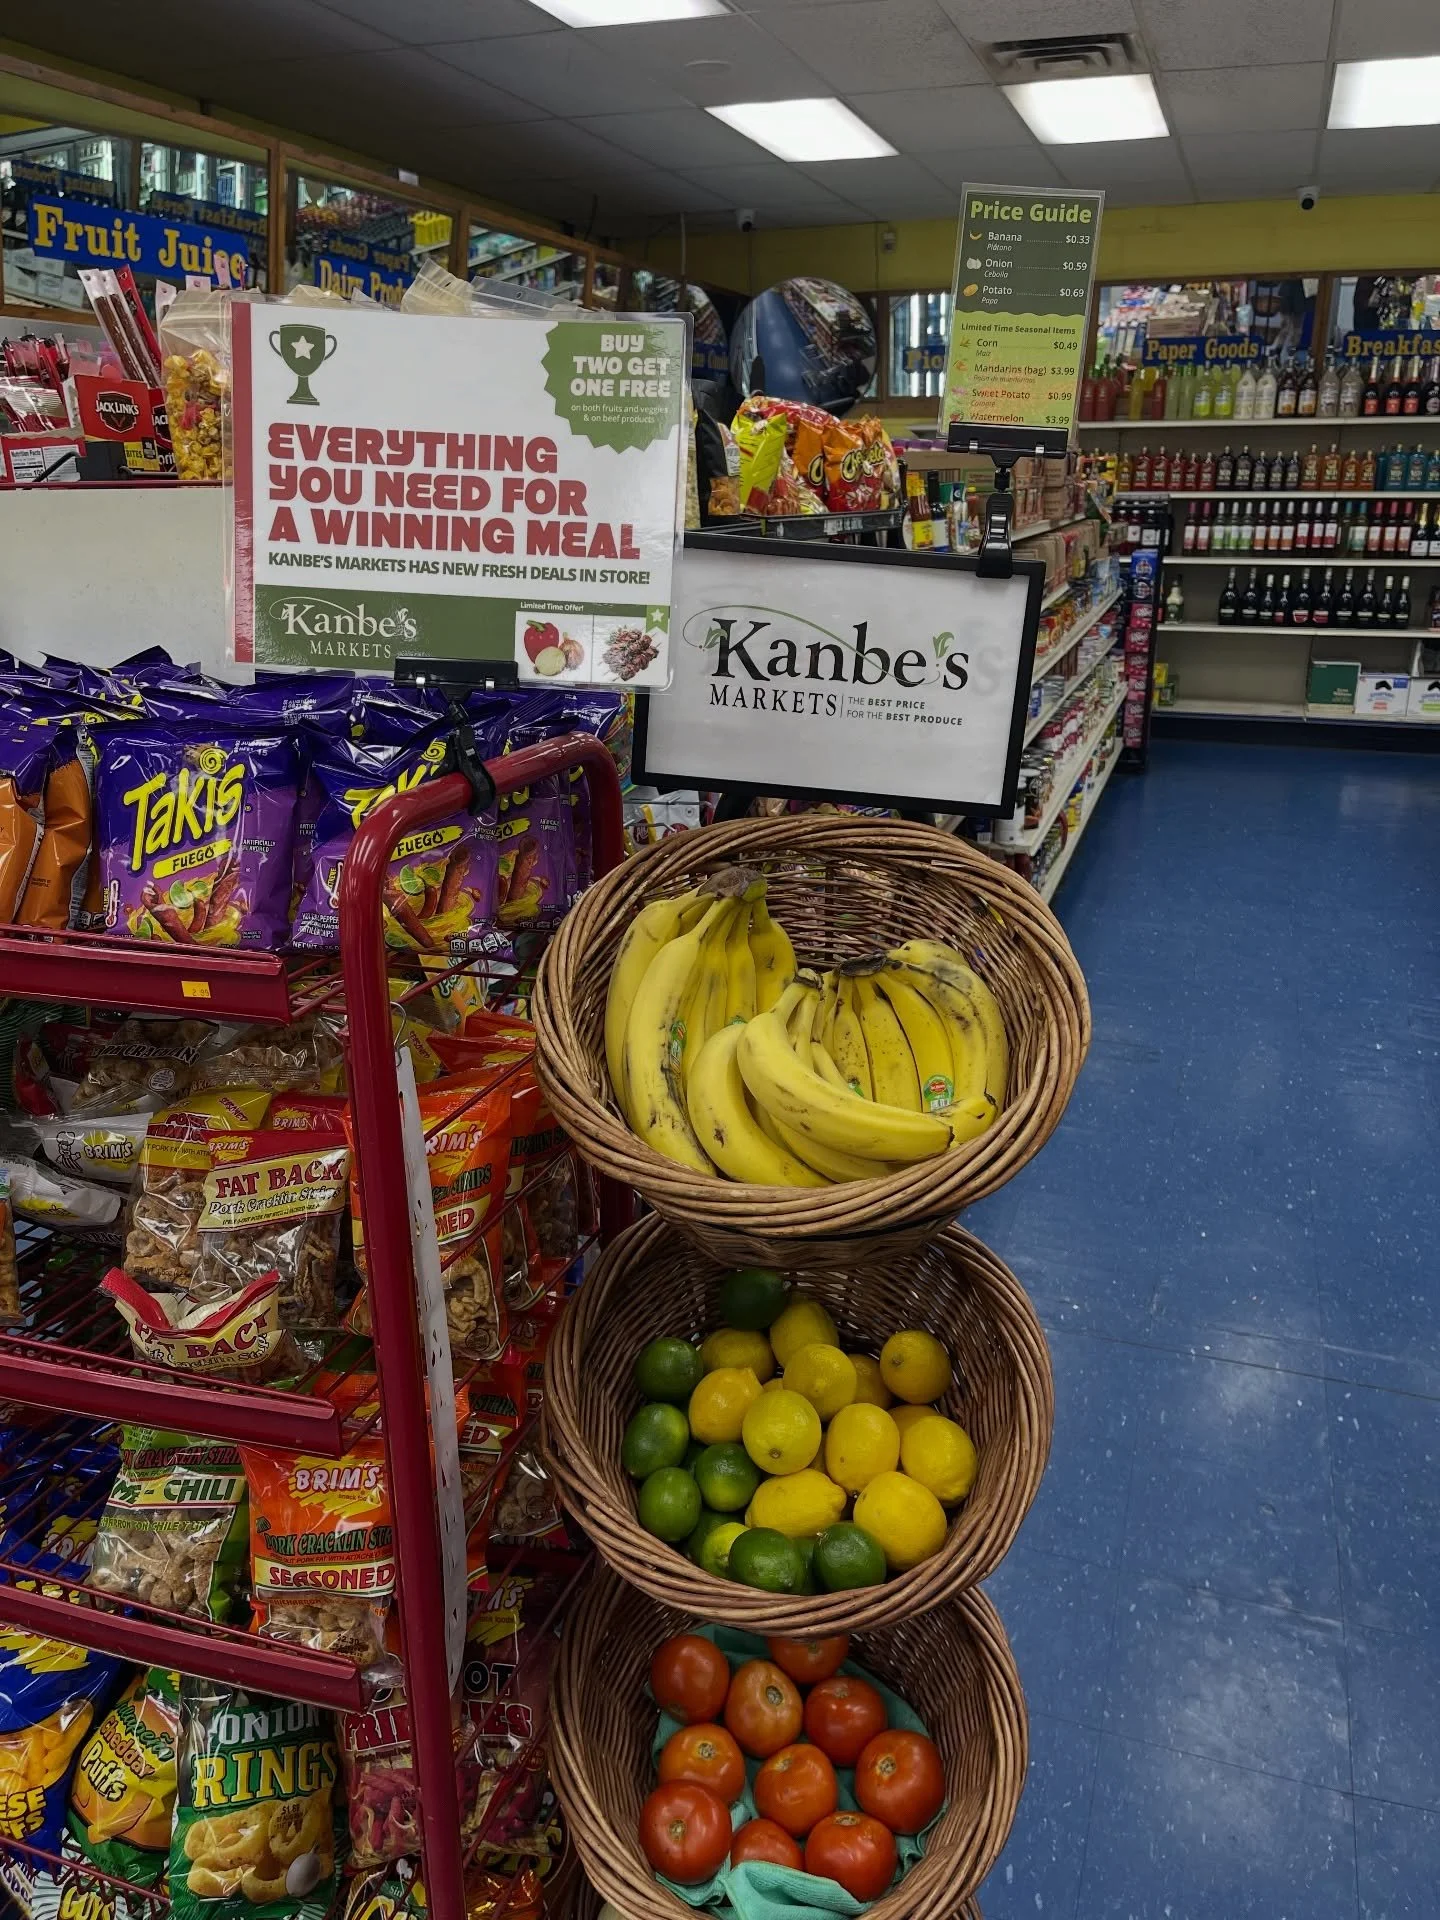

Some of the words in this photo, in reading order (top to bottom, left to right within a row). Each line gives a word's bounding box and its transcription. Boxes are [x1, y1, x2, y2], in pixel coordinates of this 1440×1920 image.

[970, 200, 1024, 221] Price
[1029, 203, 1092, 223] Guide
[33, 203, 141, 261] Fruit
[988, 231, 1022, 242] Banana
[1065, 235, 1090, 244] $0.33
[984, 270, 1008, 278] Cebolla
[985, 258, 1013, 268] Onion
[1062, 261, 1087, 271] $0.59
[982, 286, 1013, 295] Potato
[1059, 288, 1084, 298] $0.69
[961, 323, 993, 332] Limited
[994, 324, 1013, 333] Time
[1015, 325, 1051, 334] Seasonal
[1052, 327, 1076, 335] Items
[600, 334, 644, 352] BUY
[976, 338, 998, 347] Corn
[1053, 342, 1078, 351] $0.49
[1144, 338, 1197, 361] Paper
[1204, 337, 1259, 359] Goods
[573, 355, 623, 375] TWO
[627, 357, 671, 376] GET
[974, 364, 1022, 374] Mandarins
[1024, 365, 1047, 377] (bag)
[1051, 367, 1075, 376] $3.99
[570, 378, 614, 397] ONE
[619, 379, 671, 398] FREE
[972, 388, 999, 398] Sweet
[1001, 390, 1030, 400] Potato
[1048, 391, 1072, 401] $0.99
[96, 400, 115, 414] JACK
[571, 404, 581, 412] on
[582, 404, 601, 413] both
[602, 404, 623, 413] fruits
[624, 404, 639, 414] and
[640, 406, 669, 416] veggies
[970, 412, 1024, 423] Watermelon
[1045, 415, 1070, 425] $3.99
[583, 414, 590, 422] &
[602, 414, 620, 423] beef
[621, 415, 655, 425] products
[267, 422, 558, 474] EVERYTHING
[269, 464, 363, 506] YOU
[374, 470, 492, 511] NEED
[502, 476, 588, 517] FOR
[268, 506, 301, 543] A
[310, 508, 515, 555] WINNING
[526, 519, 641, 560] MEAL
[268, 551, 333, 569] KANBE'S
[335, 556, 406, 573] MARKETS
[409, 560, 440, 574] HAS
[442, 562, 479, 577] NEW
[482, 563, 527, 580] FRESH
[530, 566, 577, 582] DEALS
[579, 568, 597, 583] IN
[599, 569, 650, 585] STORE!
[520, 601, 546, 610] Limited
[547, 603, 563, 611] Time
[564, 604, 584, 612] Offer!
[281, 602, 417, 639] Kanbe's
[309, 640, 392, 659] MARKETS
[709, 617, 970, 691] Kanbe's
[709, 683, 838, 717] MARKETS
[848, 697, 865, 706] THE
[868, 698, 892, 707] BEST
[895, 700, 926, 709] PRICE
[846, 710, 864, 719] FOR
[866, 711, 883, 720] THE
[886, 712, 910, 722] BEST
[913, 714, 963, 726] PRODUCE
[397, 831, 444, 857] FUEGO
[172, 845, 216, 872] FUEGO
[451, 940, 466, 950] 150
[83, 1140, 133, 1160] BRIM'S
[209, 1137, 249, 1152] BRIM'S
[424, 1125, 483, 1157] RIM'S
[215, 1171, 260, 1199] FAT
[268, 1158, 346, 1191] BACK
[209, 1199, 245, 1216] Pork
[247, 1190, 298, 1212] Cracklin
[295, 1460, 381, 1493] BRIM'S
[163, 1478, 237, 1504] CHILI
[264, 1532, 298, 1557] PORK
[298, 1528, 368, 1555] CRACKLIN
[269, 1562, 395, 1590] SEASONED
[218, 1700, 321, 1746] ONION
[100, 1715, 156, 1779] Cheddar
[80, 1741, 127, 1803] Puffs
[192, 1740, 338, 1811] RINGS
